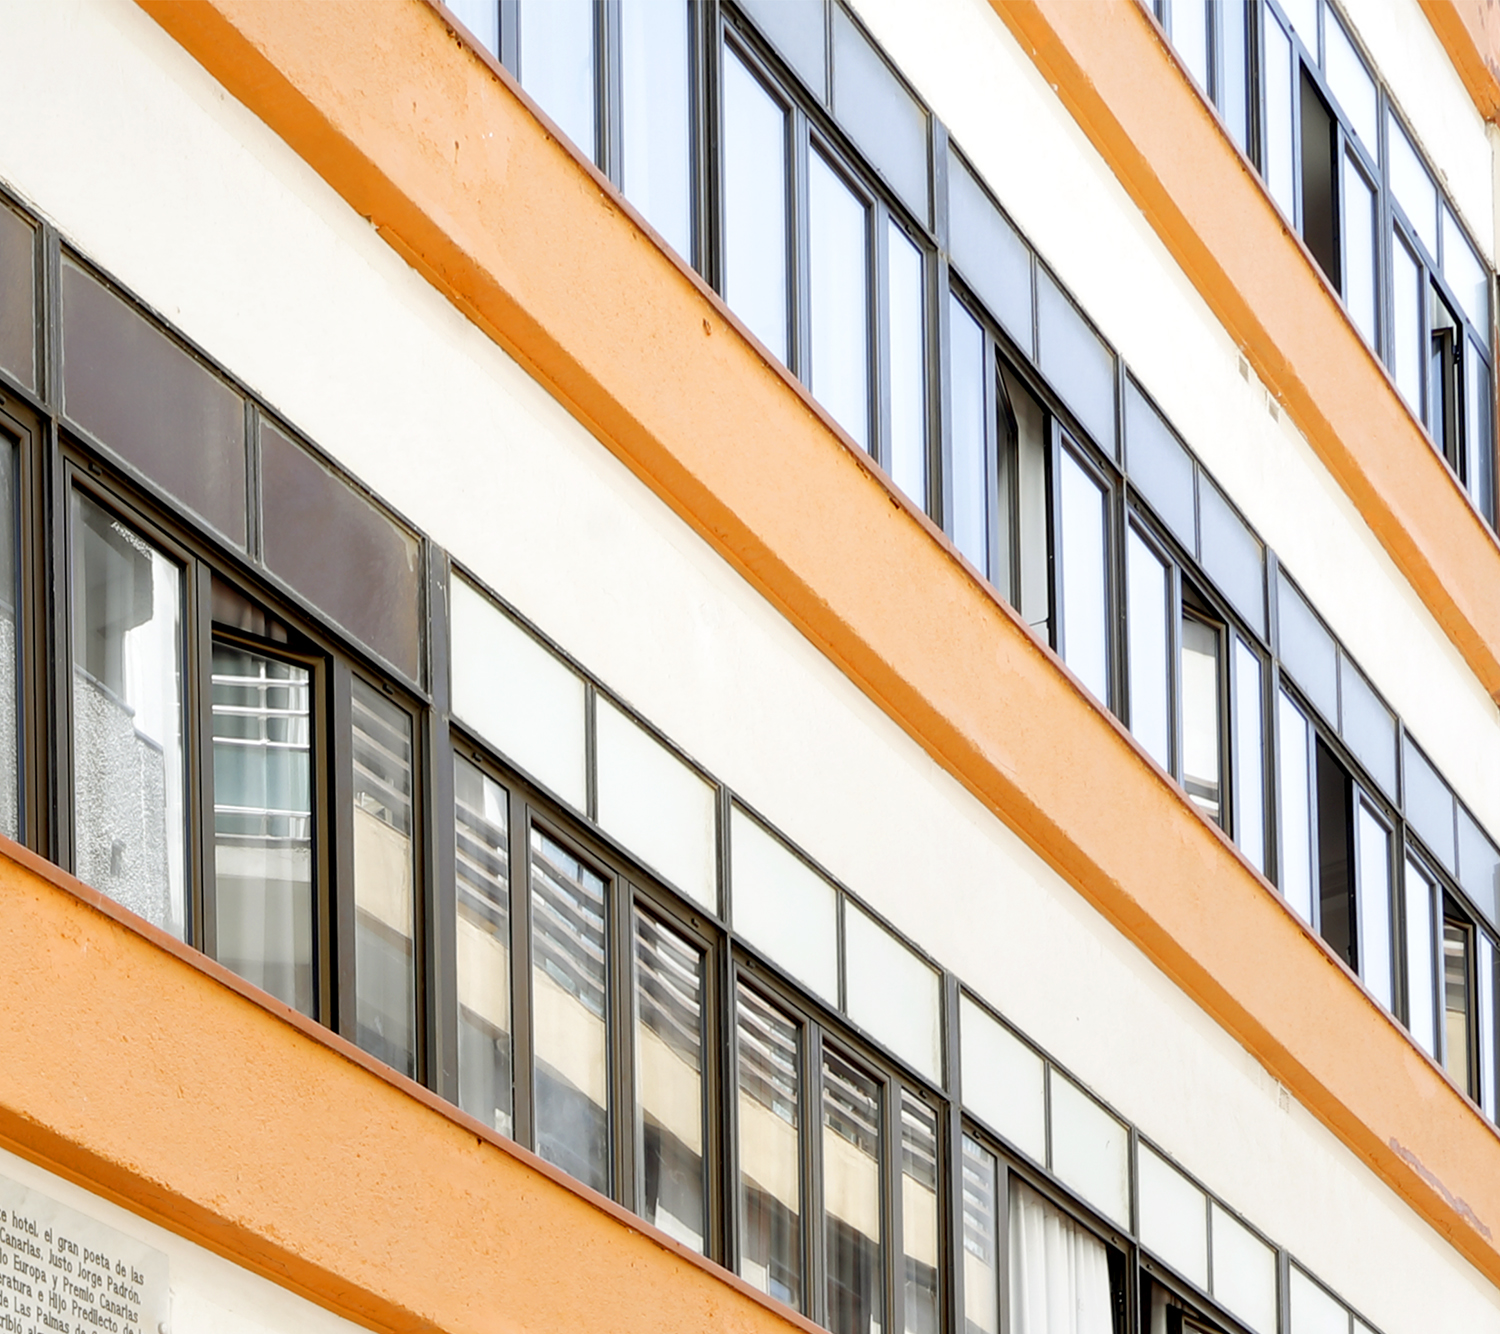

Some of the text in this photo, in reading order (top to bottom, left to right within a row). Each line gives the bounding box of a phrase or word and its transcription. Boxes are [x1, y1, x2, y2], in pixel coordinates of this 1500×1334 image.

[43, 1227, 54, 1245] el
[56, 1236, 80, 1257] gran
[82, 1247, 112, 1271] poeta
[114, 1259, 128, 1278] de
[130, 1265, 145, 1286] las
[47, 1248, 74, 1274] Justo
[76, 1261, 104, 1289] Jorge
[12, 1253, 48, 1284] Europa
[50, 1274, 59, 1292] y
[62, 1275, 96, 1304] Premio
[98, 1293, 139, 1324] Canarias
[13, 1296, 32, 1318] Las
[35, 1305, 71, 1334] Palmas
[36, 1290, 45, 1303] e
[47, 1289, 68, 1315] Hijo
[70, 1299, 119, 1334] Predilecto
